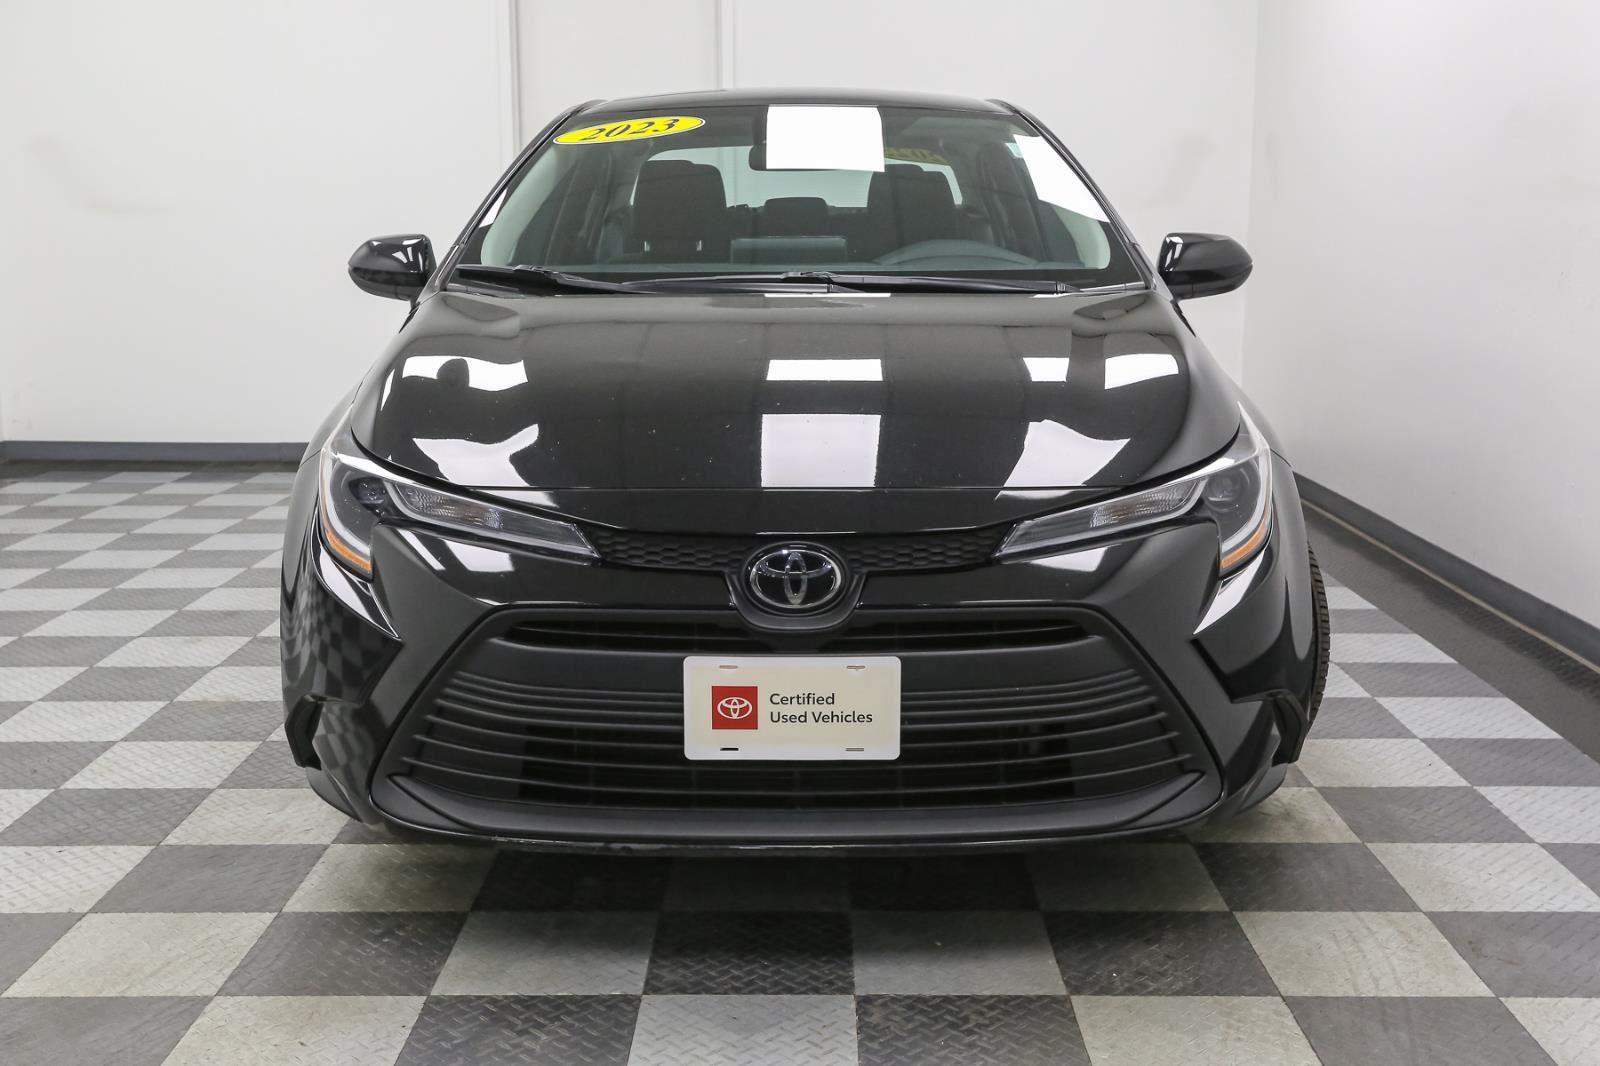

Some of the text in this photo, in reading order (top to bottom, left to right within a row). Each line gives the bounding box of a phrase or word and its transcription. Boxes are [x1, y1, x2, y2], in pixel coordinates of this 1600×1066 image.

[580, 118, 679, 141] 2023
[769, 693, 835, 705] Certified
[770, 711, 873, 723] Used Vehicles
